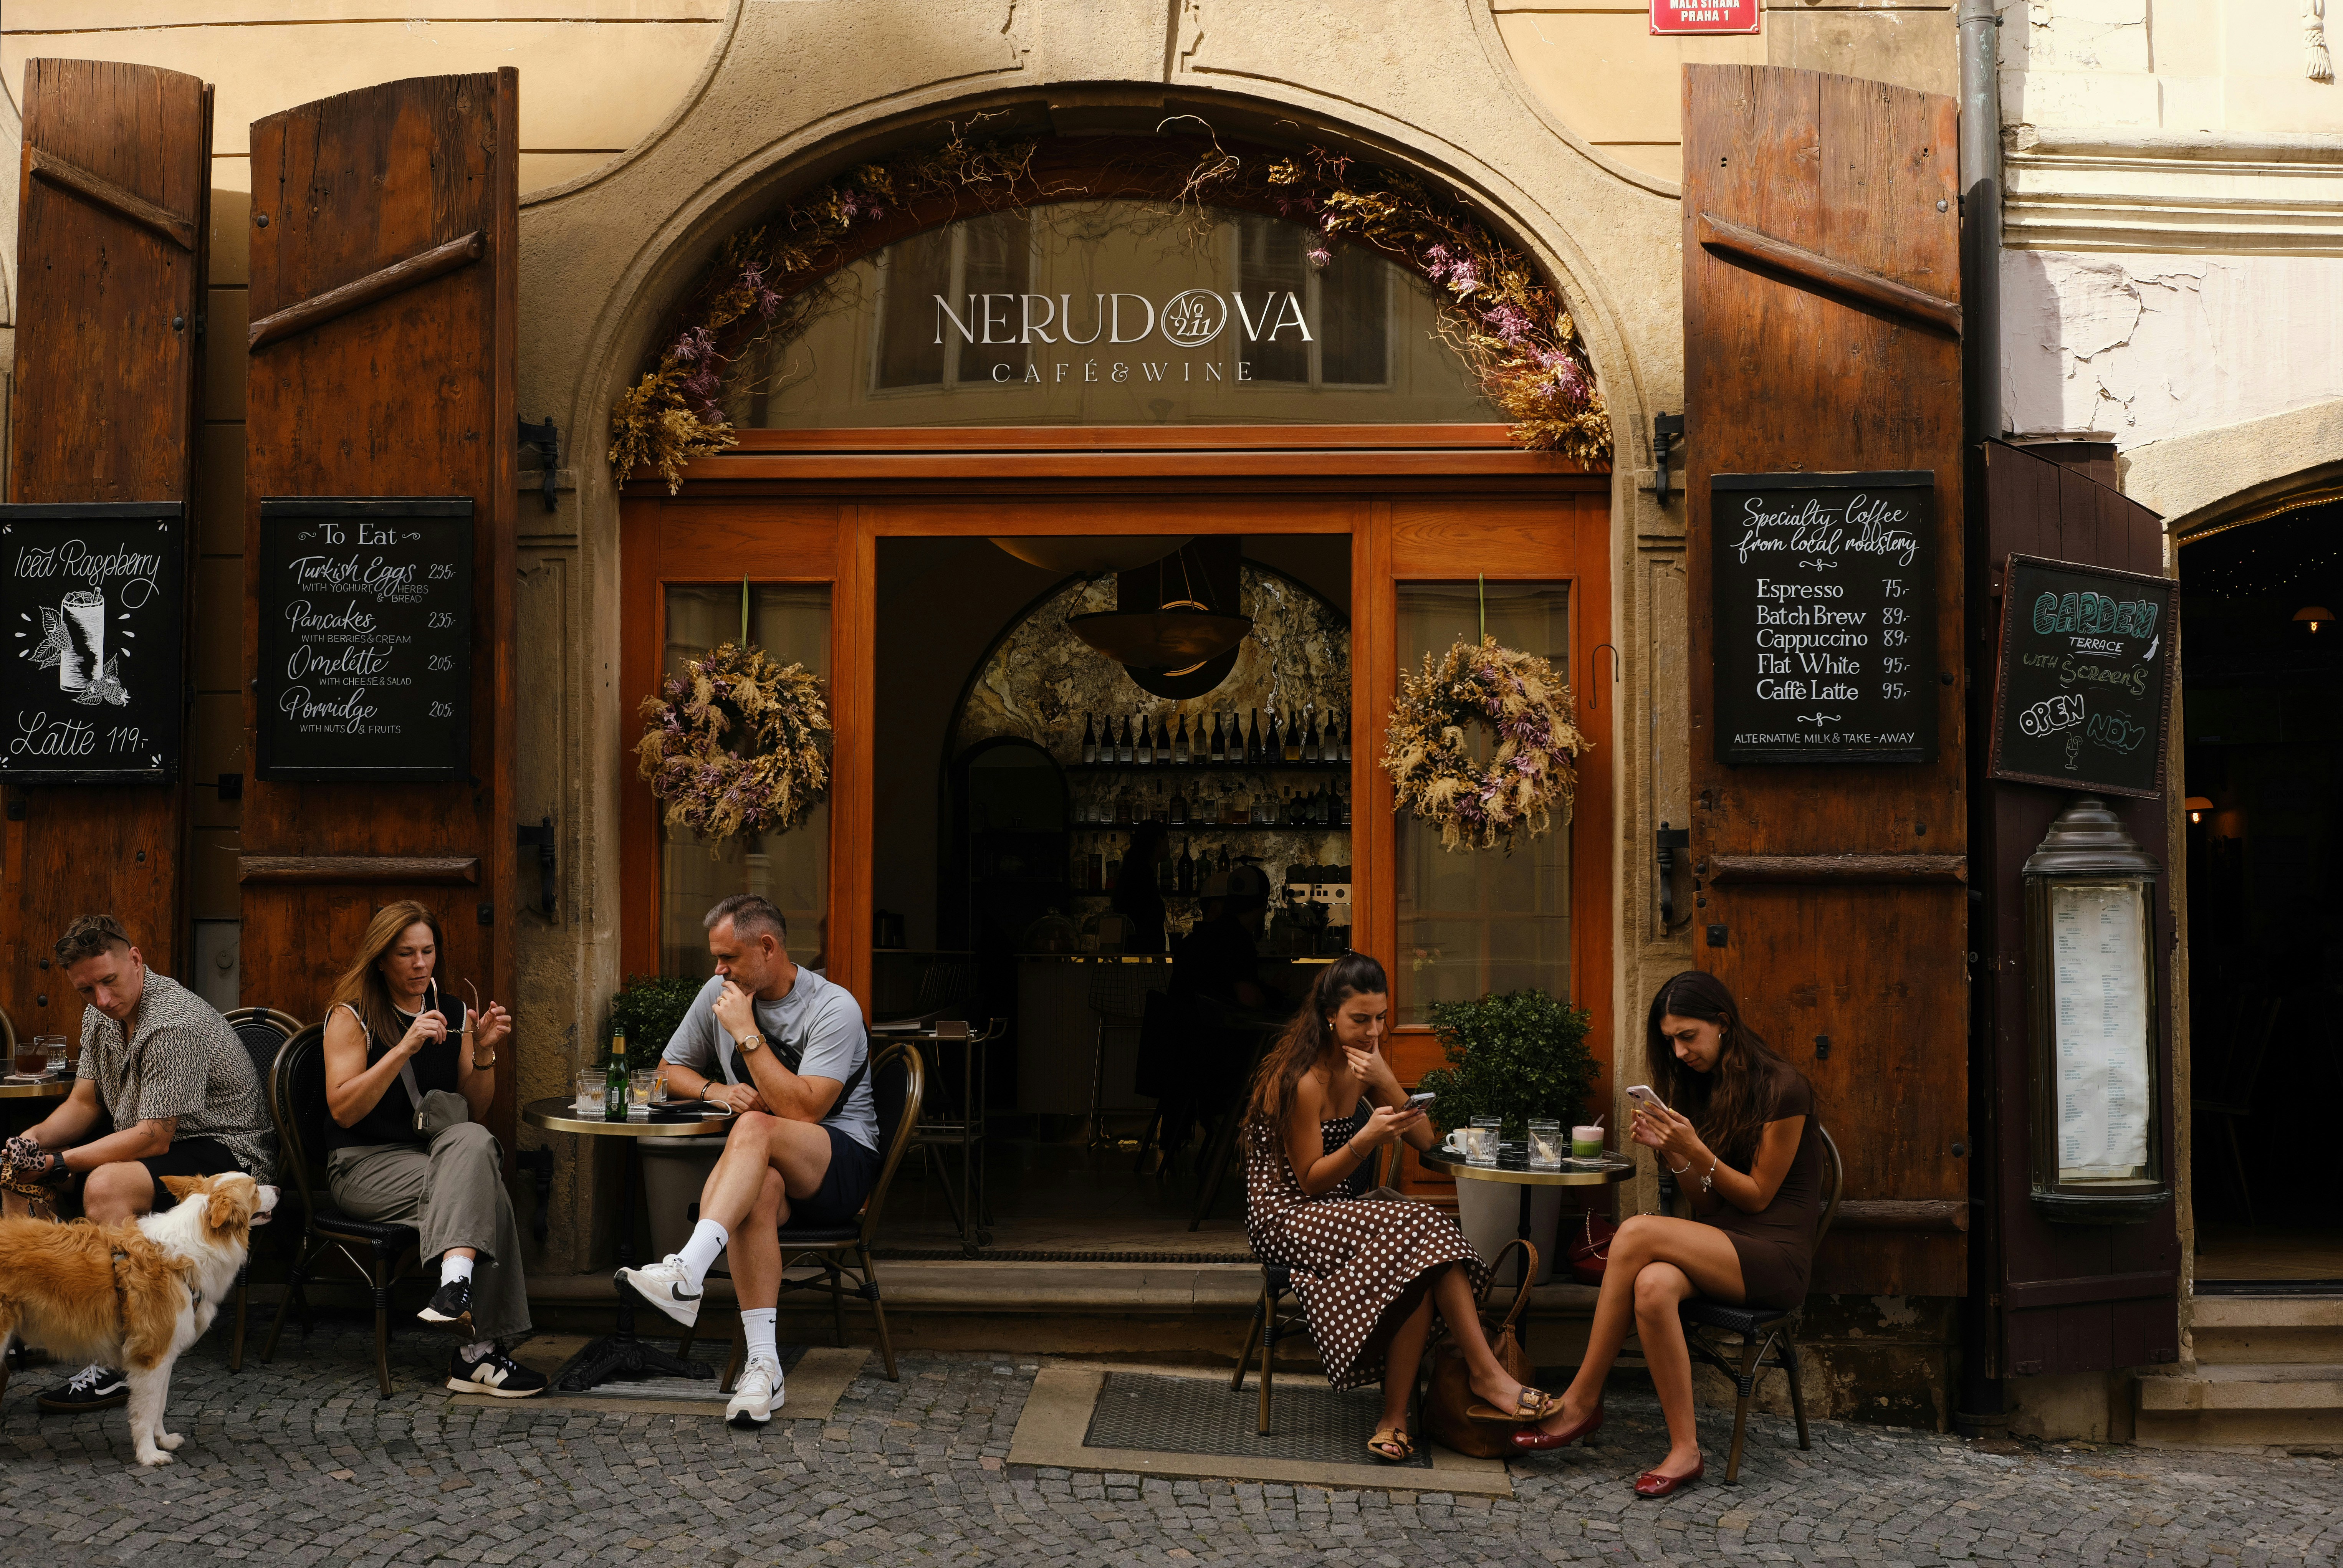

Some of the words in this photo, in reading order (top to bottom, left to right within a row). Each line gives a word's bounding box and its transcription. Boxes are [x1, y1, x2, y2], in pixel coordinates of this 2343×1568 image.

[1701, 0, 1740, 8] STRANA
[1681, 10, 1719, 22] PRAHA
[1724, 10, 1729, 21] 1
[932, 289, 1314, 347] NERUDOVA
[1175, 318, 1211, 337] 211
[1743, 497, 1843, 541] Specialty
[1846, 494, 1909, 542] Coffee
[319, 523, 345, 544] To
[357, 523, 397, 545] Eat
[1730, 530, 1787, 564] from
[1791, 526, 1843, 554] local
[1845, 530, 1919, 566] roastery
[15, 546, 57, 577] Iced
[60, 539, 161, 608] Raspberry
[289, 554, 361, 585] Turkish
[364, 556, 416, 597] Eggs
[302, 583, 327, 592] WITH
[330, 583, 374, 595] YOGHURT,
[397, 584, 429, 594] HERBS
[376, 593, 384, 602] &
[392, 594, 422, 603] BREAD
[1757, 579, 1843, 603] Espresso
[285, 600, 377, 633] Pancakes
[1757, 605, 1810, 625] Batch
[1814, 605, 1866, 625] Brew
[2034, 592, 2158, 639] GARDEN
[301, 634, 324, 642] WITH
[1757, 629, 1868, 653] Cappuccino
[2069, 637, 2124, 652] TERRACE
[288, 645, 393, 680] Omelette
[1757, 653, 1792, 674] Flat
[1799, 653, 1860, 674] White
[2023, 653, 2057, 668] WITH
[343, 677, 378, 686] CHEESE
[387, 677, 412, 686] SALAD
[1757, 679, 1807, 700] Caffè
[1811, 680, 1858, 700] Latte
[280, 685, 378, 734] Porridge
[2020, 694, 2085, 735] OPEN
[10, 711, 95, 755] Latte
[300, 724, 322, 733] WITH
[324, 724, 345, 733] NUTS
[358, 724, 366, 734] &
[369, 725, 401, 734] FRUITS
[1734, 733, 1801, 743] ALTERNATIVE
[1805, 734, 1830, 743] MILK
[2087, 713, 2146, 751] NOW
[2262, 789, 2308, 800] GUINNESS
